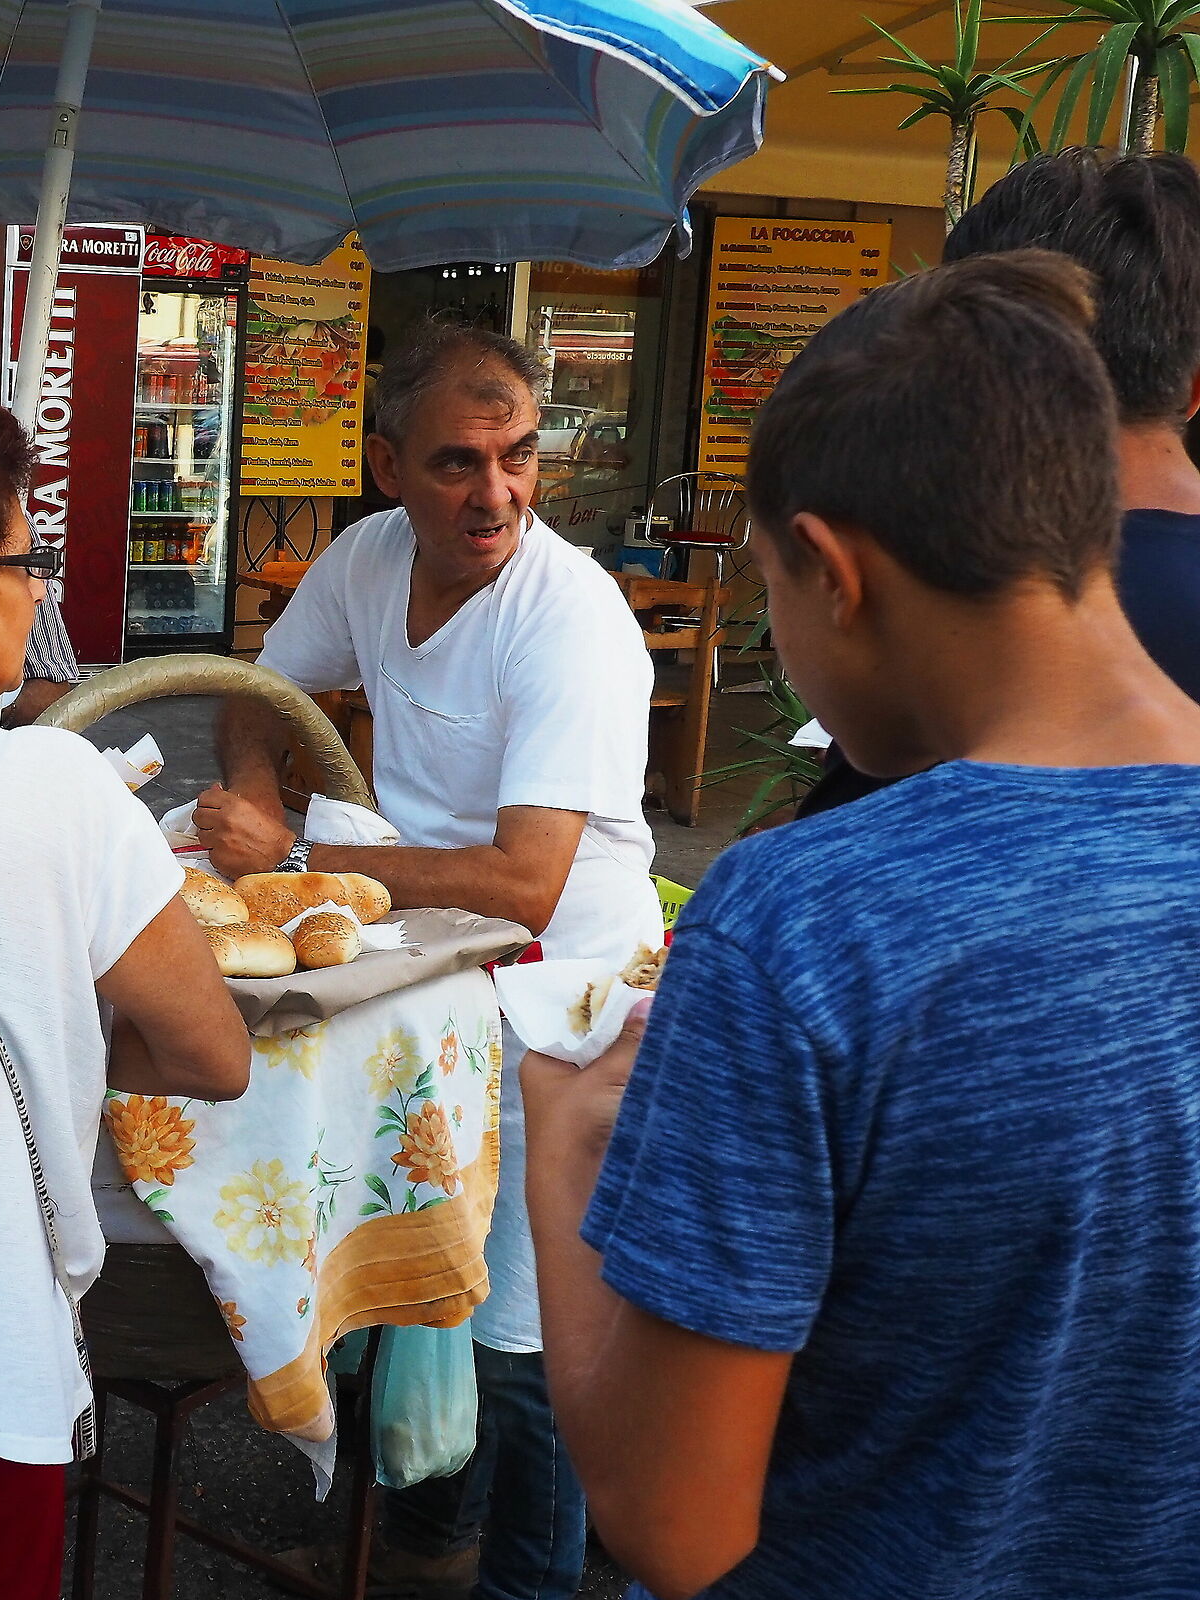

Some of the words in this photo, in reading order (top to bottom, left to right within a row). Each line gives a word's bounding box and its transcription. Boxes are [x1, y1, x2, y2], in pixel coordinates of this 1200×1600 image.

[750, 226, 768, 240] LA
[772, 228, 856, 243] FOCACCINA
[82, 239, 139, 256] MORETTI
